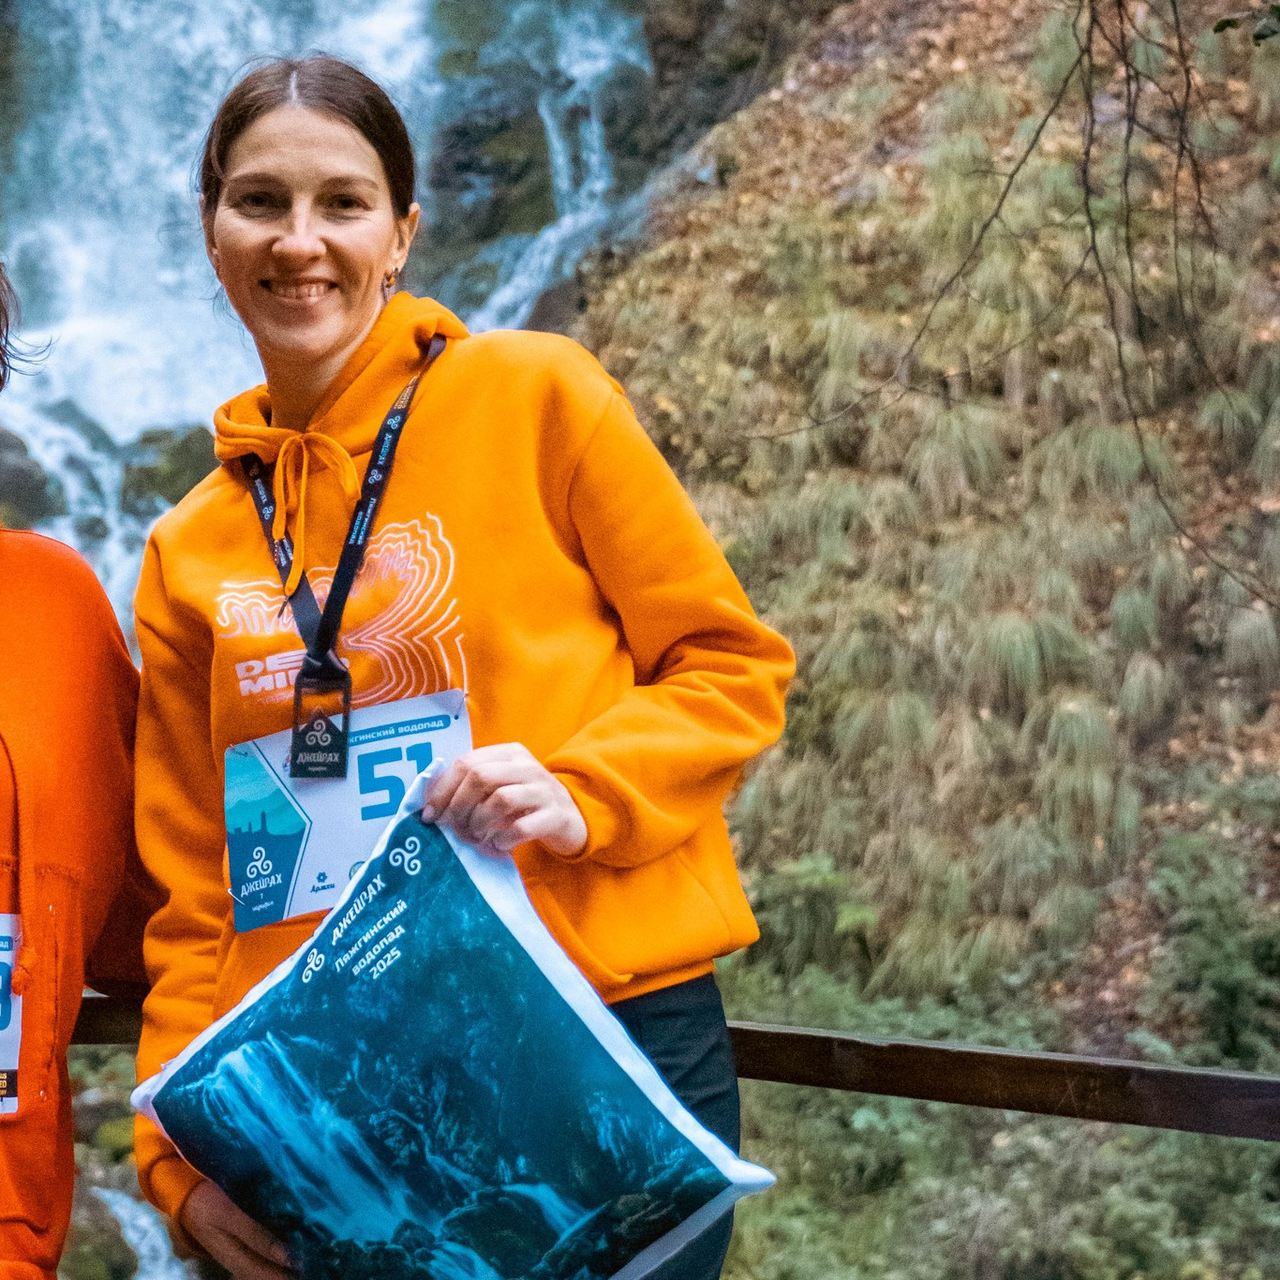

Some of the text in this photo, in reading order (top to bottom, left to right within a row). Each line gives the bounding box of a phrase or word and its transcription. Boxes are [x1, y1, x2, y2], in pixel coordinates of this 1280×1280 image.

[349, 720, 444, 743] гинский водопад
[296, 752, 340, 763] ДЖЕЙРАХ
[241, 874, 282, 898] ДЖЕЙРАХ
[331, 874, 386, 946] ДЖЕЙРАХ
[335, 899, 407, 972] Ляжгинский
[352, 924, 405, 975] водопад
[369, 946, 401, 979] 2025
